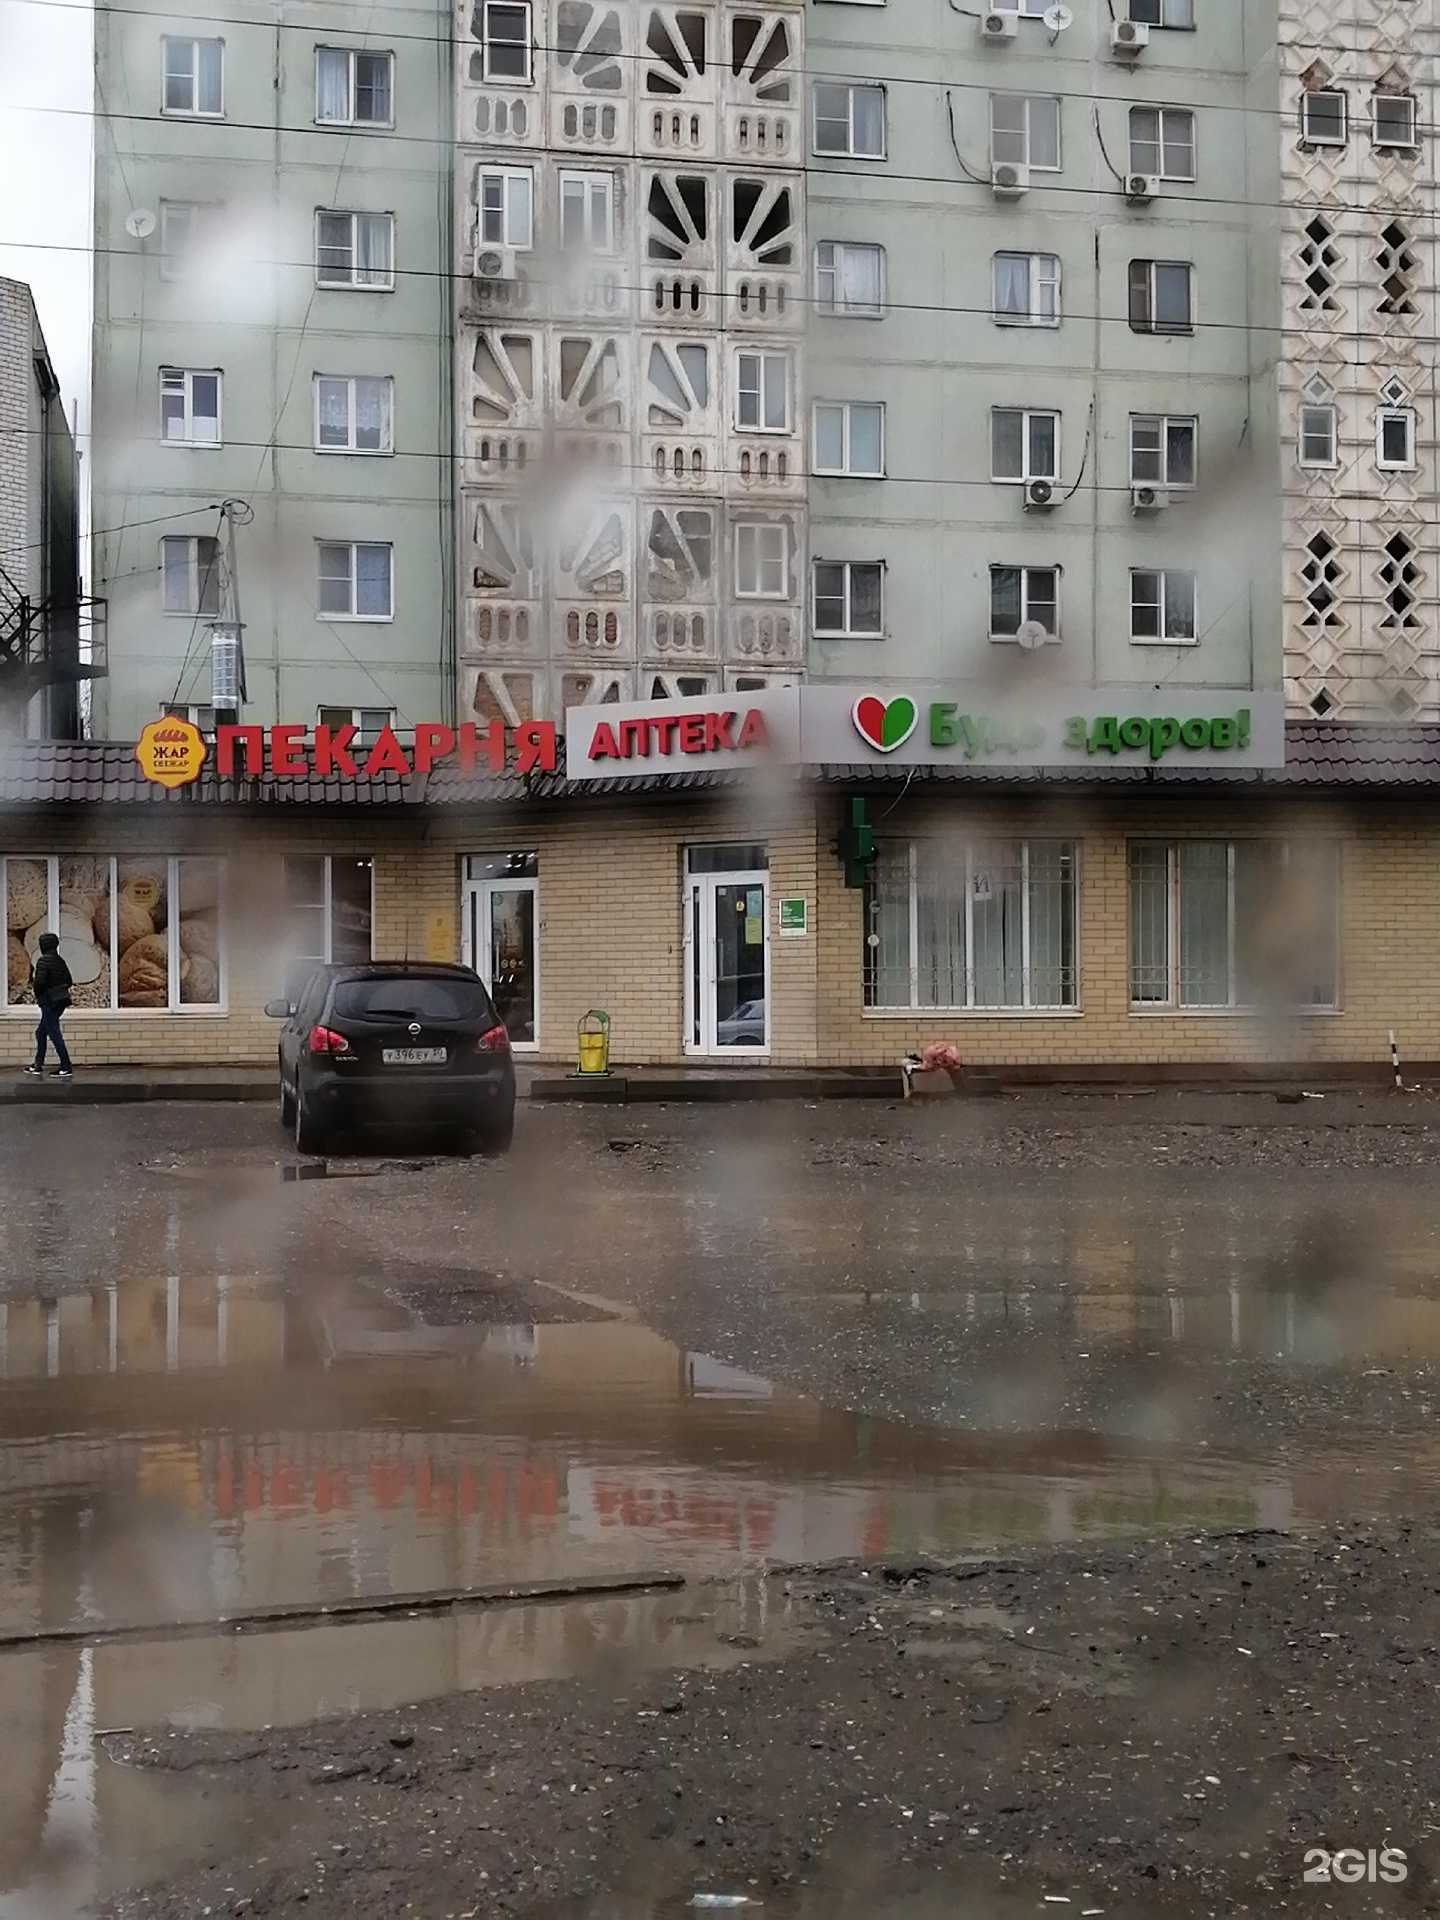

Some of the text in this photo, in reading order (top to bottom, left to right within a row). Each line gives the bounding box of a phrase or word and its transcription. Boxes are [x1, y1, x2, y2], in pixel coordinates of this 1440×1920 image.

[153, 746, 189, 759] ЖАР
[217, 720, 556, 776] ПЕКАРНЯ
[588, 708, 771, 761] АПТЕКА
[929, 702, 1251, 761] Бу здоров!
